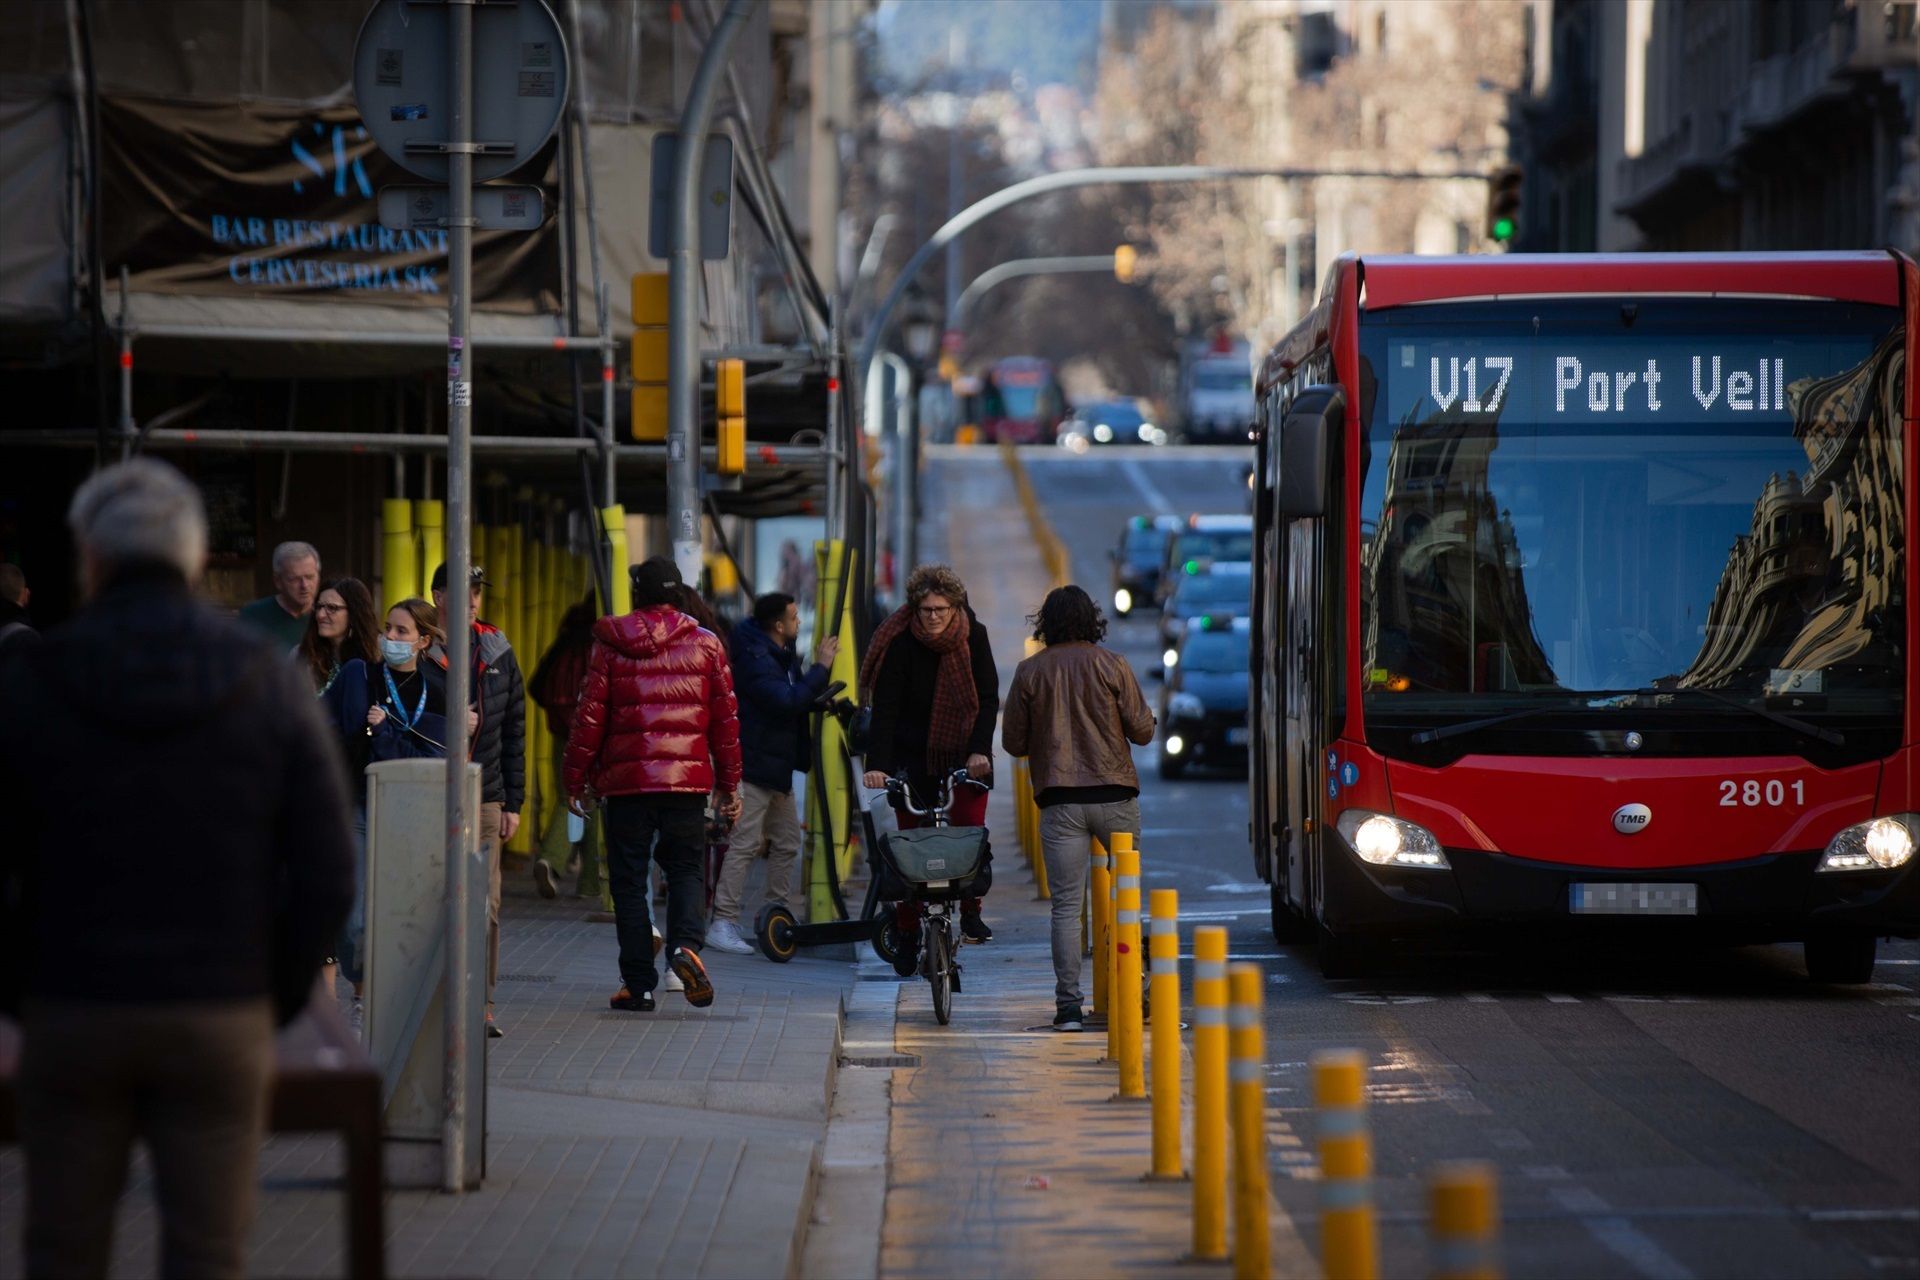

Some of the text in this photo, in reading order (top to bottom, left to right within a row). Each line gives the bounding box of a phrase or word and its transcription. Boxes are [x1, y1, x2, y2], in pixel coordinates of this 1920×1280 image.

[211, 215, 449, 253] BAR RESTAURANT
[229, 256, 440, 294] CERVESERIA SK
[1431, 356, 1784, 412] V17 Port Vell
[1719, 780, 1804, 806] 2801
[1619, 814, 1647, 825] TMB
